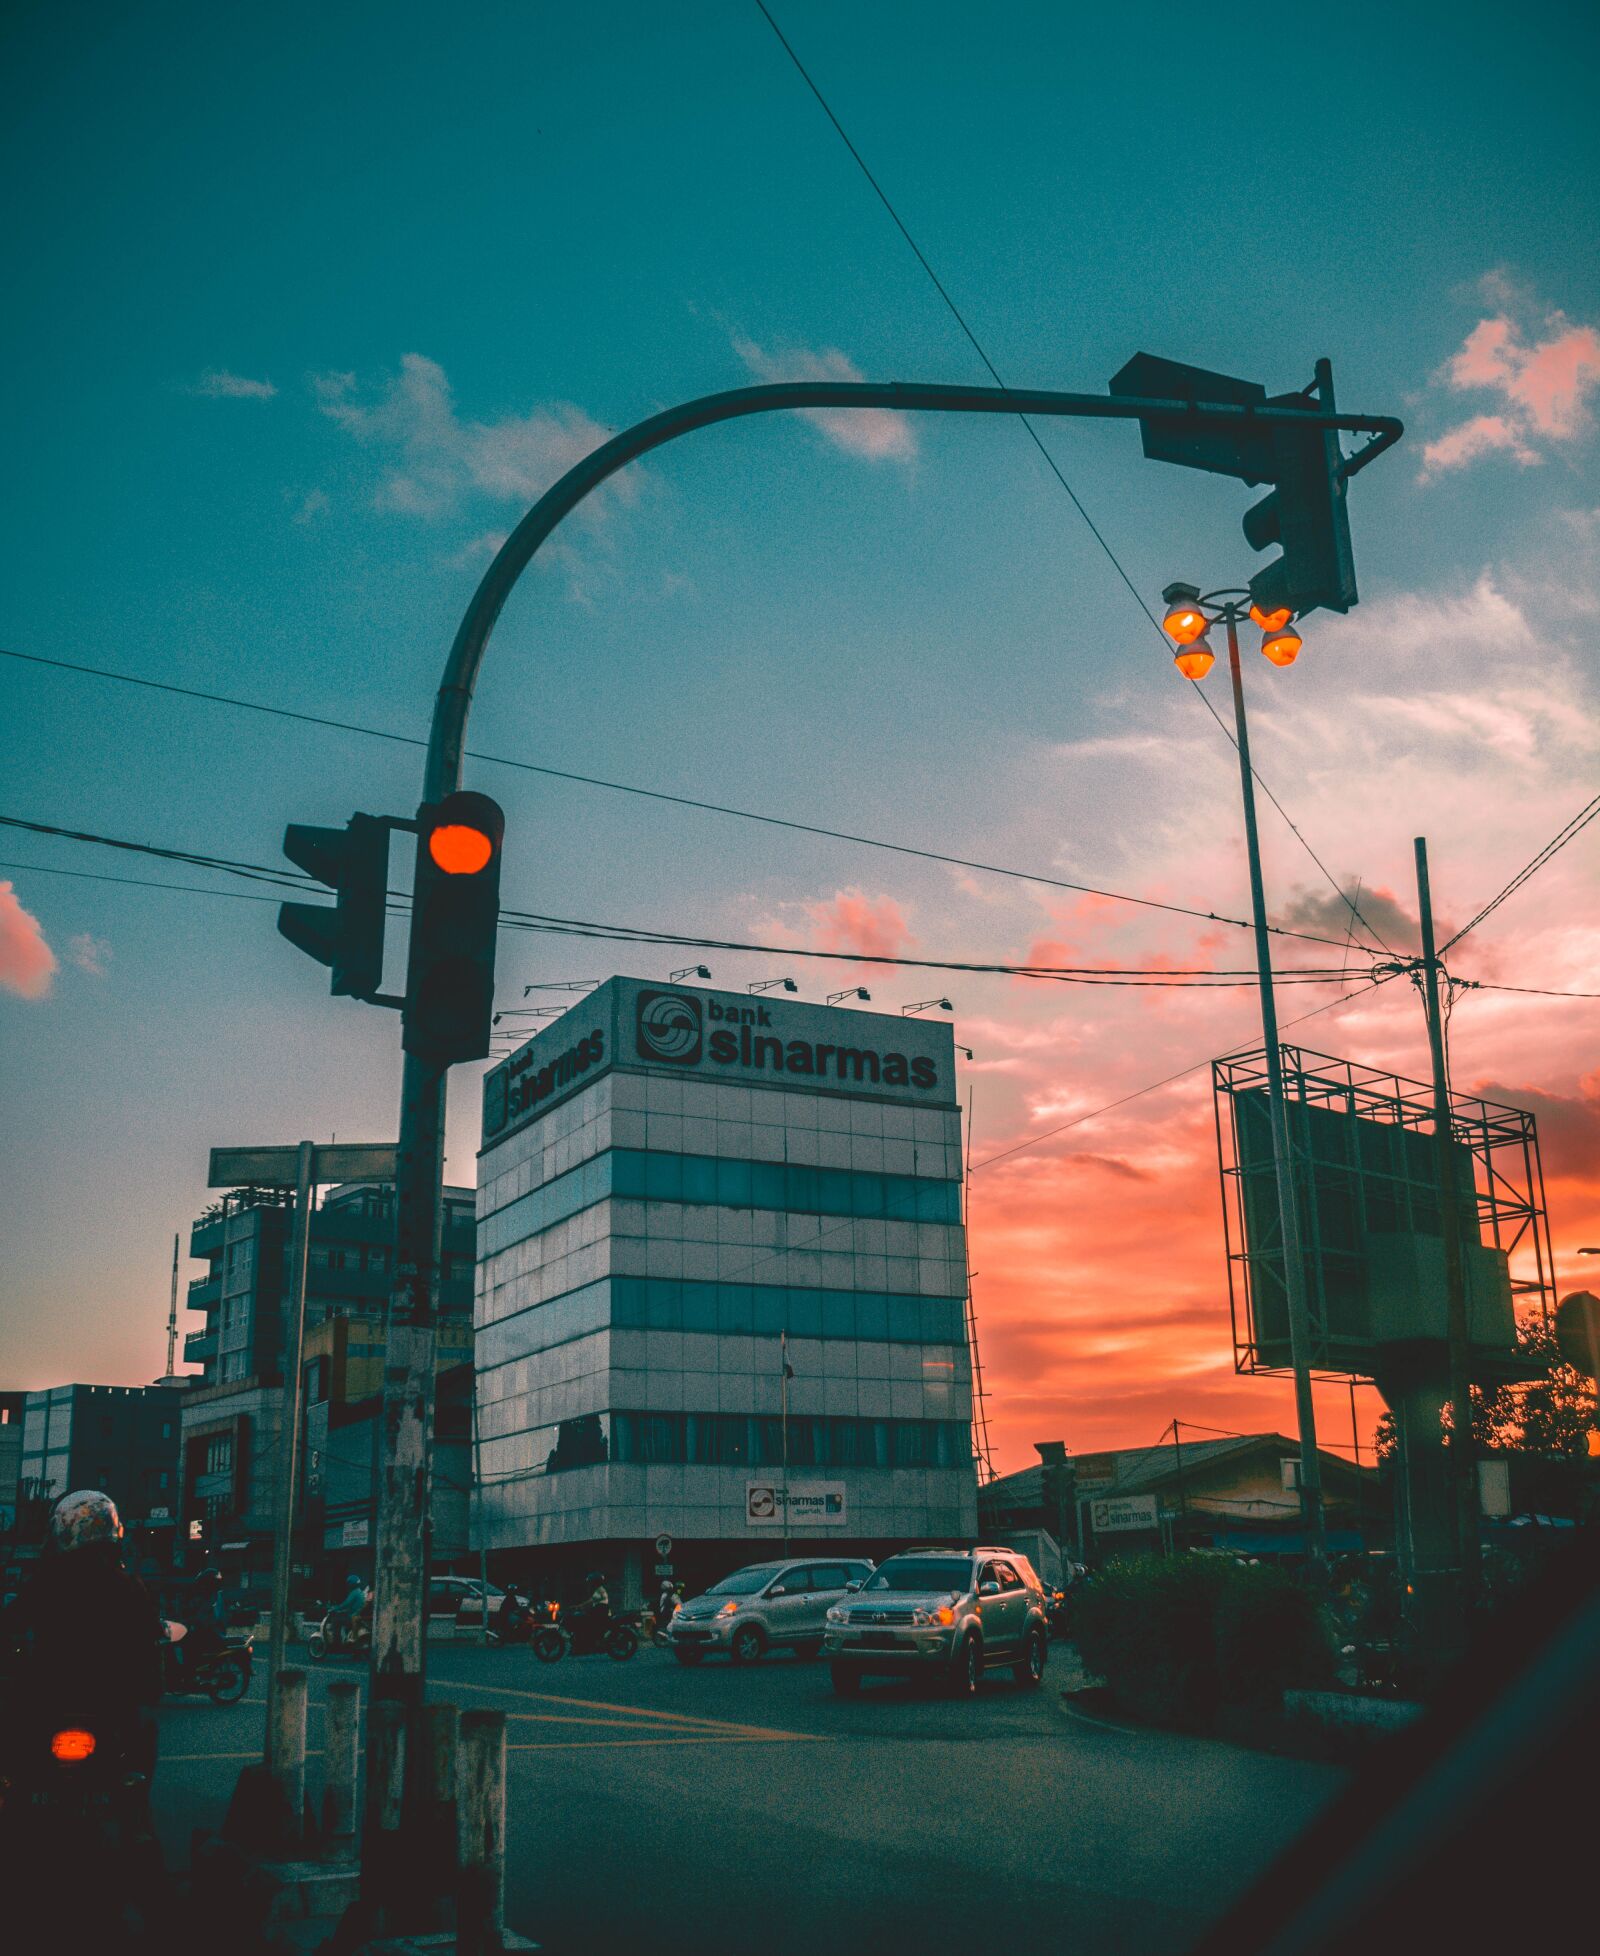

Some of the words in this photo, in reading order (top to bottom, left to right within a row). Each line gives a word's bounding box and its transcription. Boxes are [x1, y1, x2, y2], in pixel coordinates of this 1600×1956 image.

[708, 999, 772, 1027] bank
[708, 1025, 937, 1089] sinarmas
[510, 1029, 604, 1117] sinarmas
[775, 1495, 825, 1505] sinarmas
[1110, 1511, 1153, 1524] sinarmas
